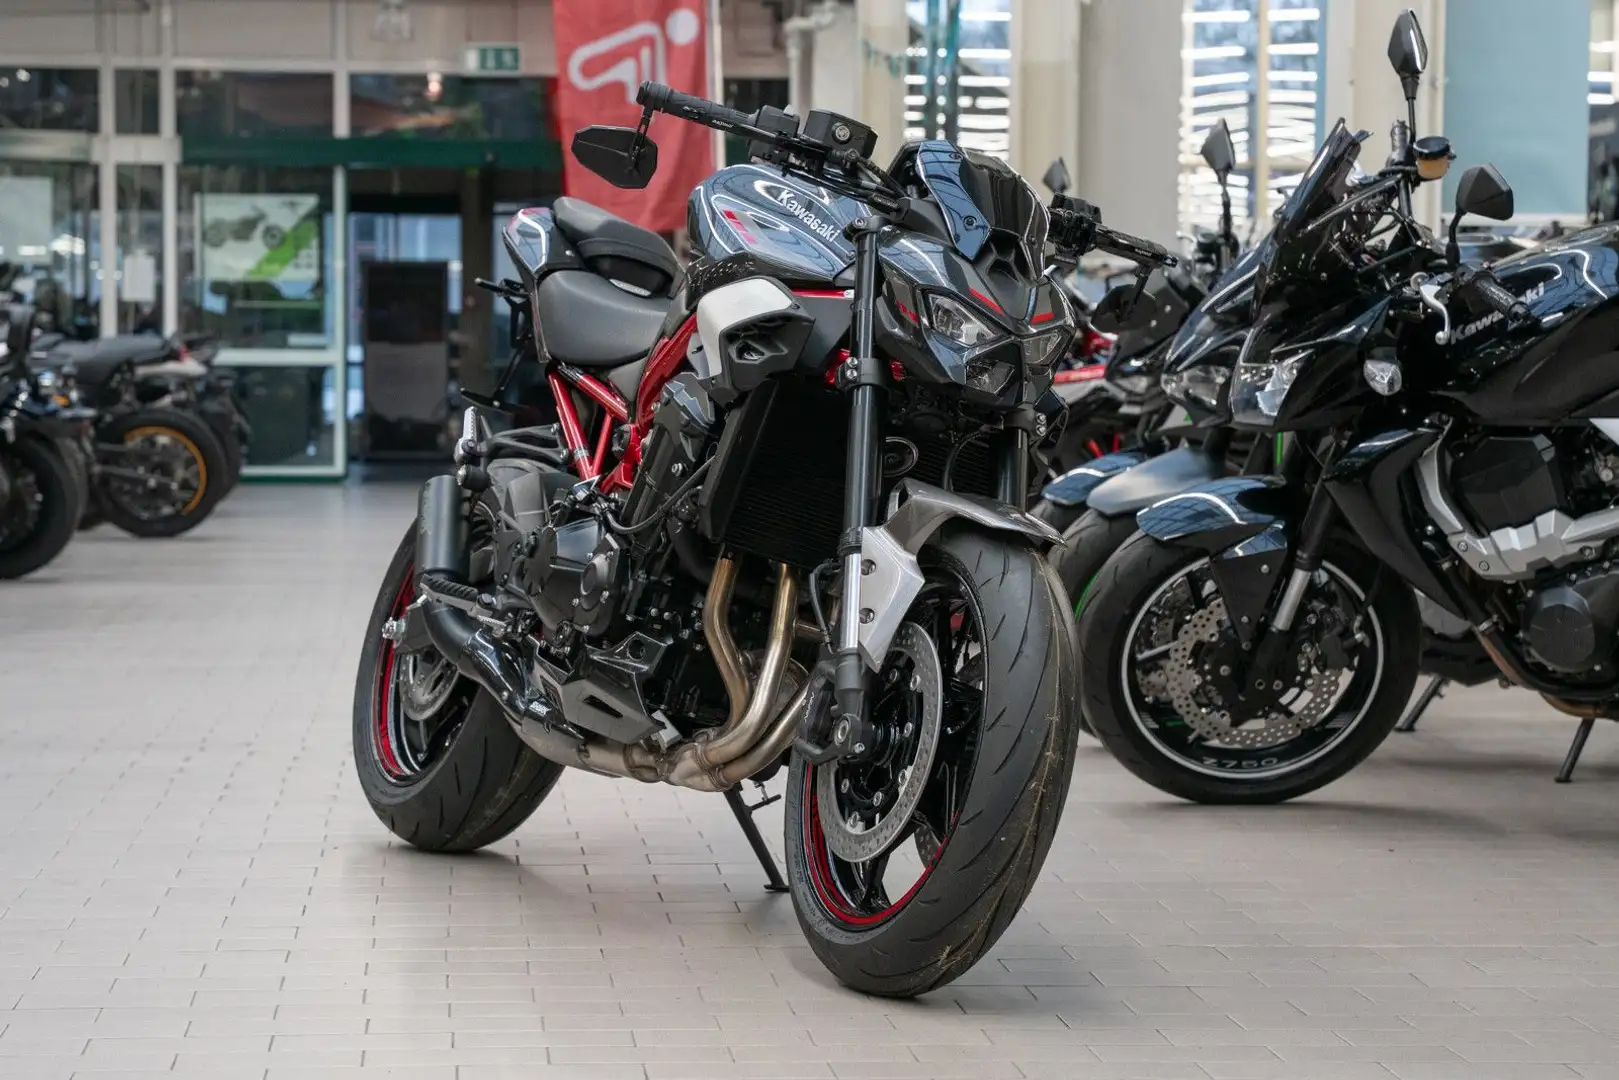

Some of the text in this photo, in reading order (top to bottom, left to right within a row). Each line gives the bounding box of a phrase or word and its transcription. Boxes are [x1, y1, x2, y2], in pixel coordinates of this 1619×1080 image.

[777, 189, 840, 242] Kawasaki
[1451, 281, 1544, 345] Kawaki
[1202, 756, 1278, 769] Z750
